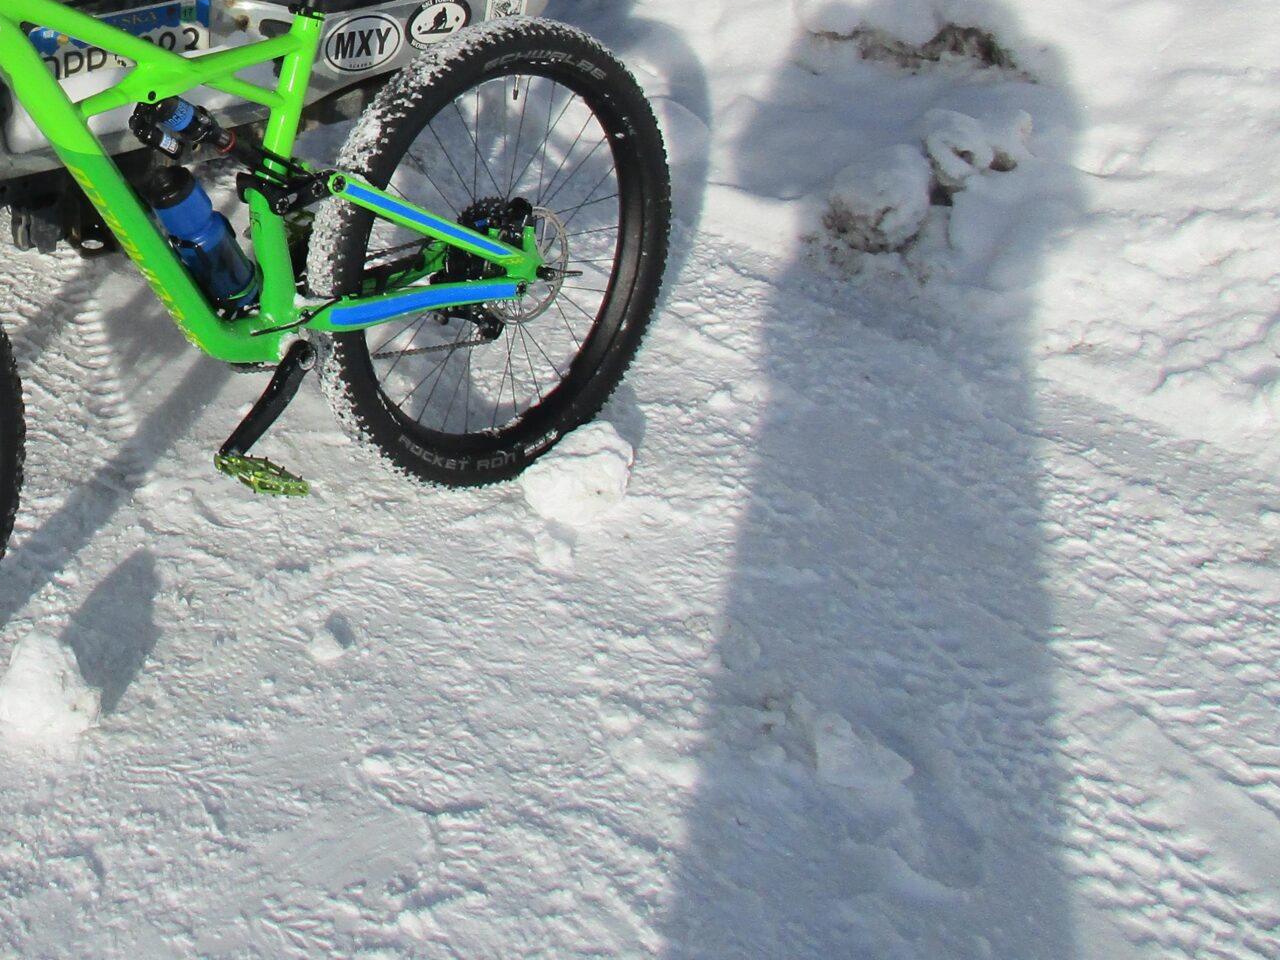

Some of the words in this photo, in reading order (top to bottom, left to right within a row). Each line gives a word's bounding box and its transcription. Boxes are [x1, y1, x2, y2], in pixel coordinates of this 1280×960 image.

[421, 0, 433, 10] SKI
[334, 27, 392, 61] MXY
[483, 49, 607, 81] SCHWALBE
[398, 434, 469, 471] ROCKET
